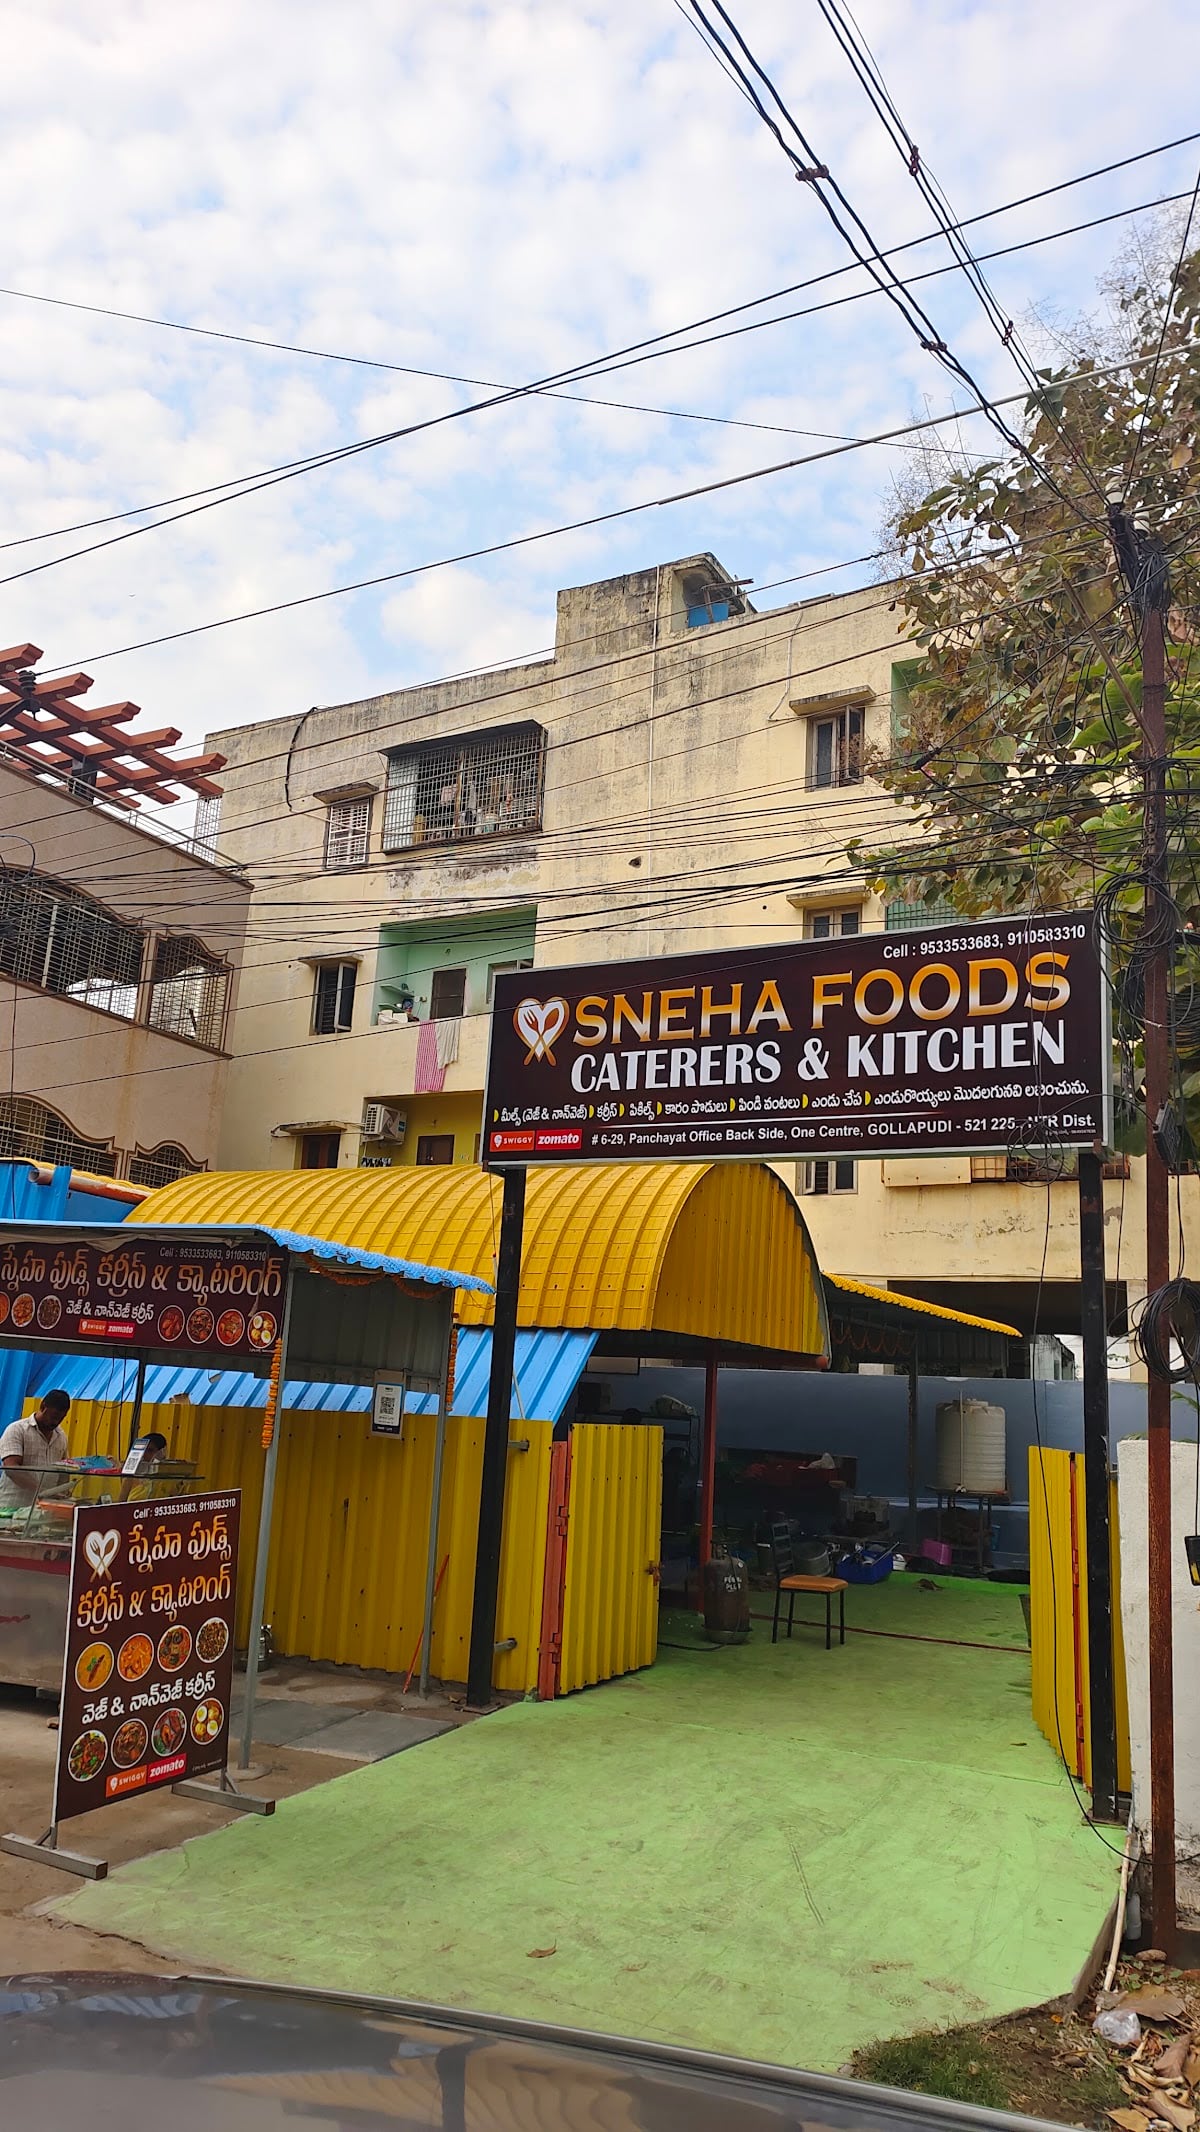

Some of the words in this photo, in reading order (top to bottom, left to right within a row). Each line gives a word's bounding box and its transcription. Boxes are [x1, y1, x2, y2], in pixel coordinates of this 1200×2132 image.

[883, 944, 908, 958] Cell
[920, 934, 1003, 955] 9533533683,
[1008, 924, 1085, 946] 9110583310
[573, 979, 793, 1046] SNEHA
[811, 951, 1071, 1030] FOODS
[571, 1041, 781, 1093] CATERERS
[797, 1038, 829, 1082] &
[847, 1019, 1064, 1078] KITCHEN
[501, 1107, 521, 1126] మీల్స్
[541, 1107, 550, 1120] &
[629, 1101, 655, 1120] పికిల్స్
[664, 1103, 689, 1114] కారం
[738, 1095, 762, 1111] పిండి
[763, 1095, 801, 1110] వంటలు
[811, 1093, 840, 1109] ఎండు
[842, 1089, 863, 1107] చేప
[503, 1136, 533, 1144] SWIGGY
[538, 1133, 580, 1145] zomato
[591, 1134, 599, 1146] #
[601, 1133, 626, 1146] 6-29,
[629, 1130, 686, 1146] Panchayat
[689, 1129, 723, 1142] Office
[726, 1128, 754, 1141] Back
[758, 1126, 788, 1141] Side,
[791, 1125, 815, 1139] One
[819, 1123, 864, 1138] Centre,
[868, 1120, 952, 1136] GOLLAPUDI
[965, 1118, 987, 1132] 521
[1063, 1114, 1096, 1127] Dist.
[1, 1244, 46, 1292] స్నేహ
[151, 1264, 173, 1291] &
[160, 1247, 174, 1257] Cell
[225, 1249, 267, 1261] 9110583310
[83, 1301, 92, 1316] &
[133, 1508, 148, 1520] Cell
[154, 1502, 198, 1516] 9533533683,
[199, 1498, 236, 1511] 9110583310
[128, 1523, 182, 1573] స్నేహ
[128, 1590, 147, 1617] &
[81, 1697, 109, 1725] వెజ్
[110, 1696, 125, 1717] &
[119, 1771, 146, 1786] SWIGGY
[150, 1759, 185, 1778] zomato
